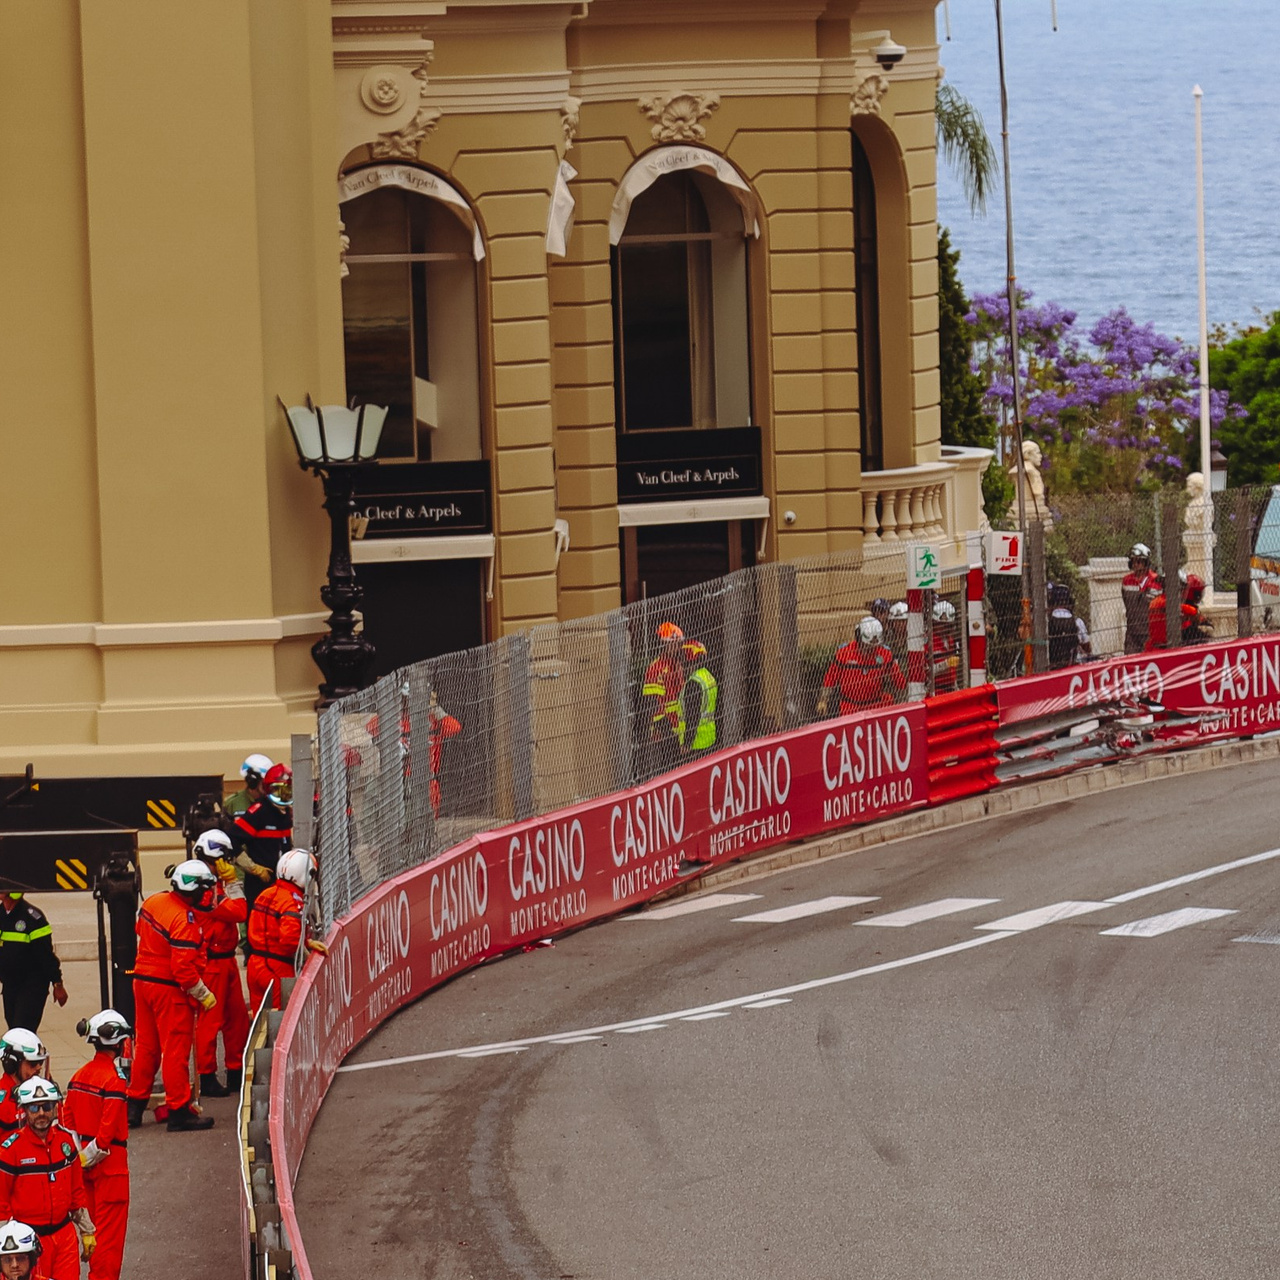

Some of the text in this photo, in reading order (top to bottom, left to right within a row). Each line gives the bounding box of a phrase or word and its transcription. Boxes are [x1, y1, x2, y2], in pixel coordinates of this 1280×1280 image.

[637, 466, 740, 485] Van Cleef & Arpels
[366, 505, 402, 520] Cleef
[405, 507, 415, 519] &
[418, 503, 462, 521] Arpels
[822, 716, 912, 791] CASINO
[709, 746, 791, 825] CASINO
[823, 777, 913, 823] MONTE CARLO
[610, 782, 685, 867] CASINO
[508, 818, 585, 901] CASINO
[612, 868, 649, 902] MONTE
[430, 851, 489, 941] CASINO
[510, 888, 587, 937] MONTE CARLO
[367, 889, 411, 982] CASINO
[462, 923, 491, 961] CARLO
